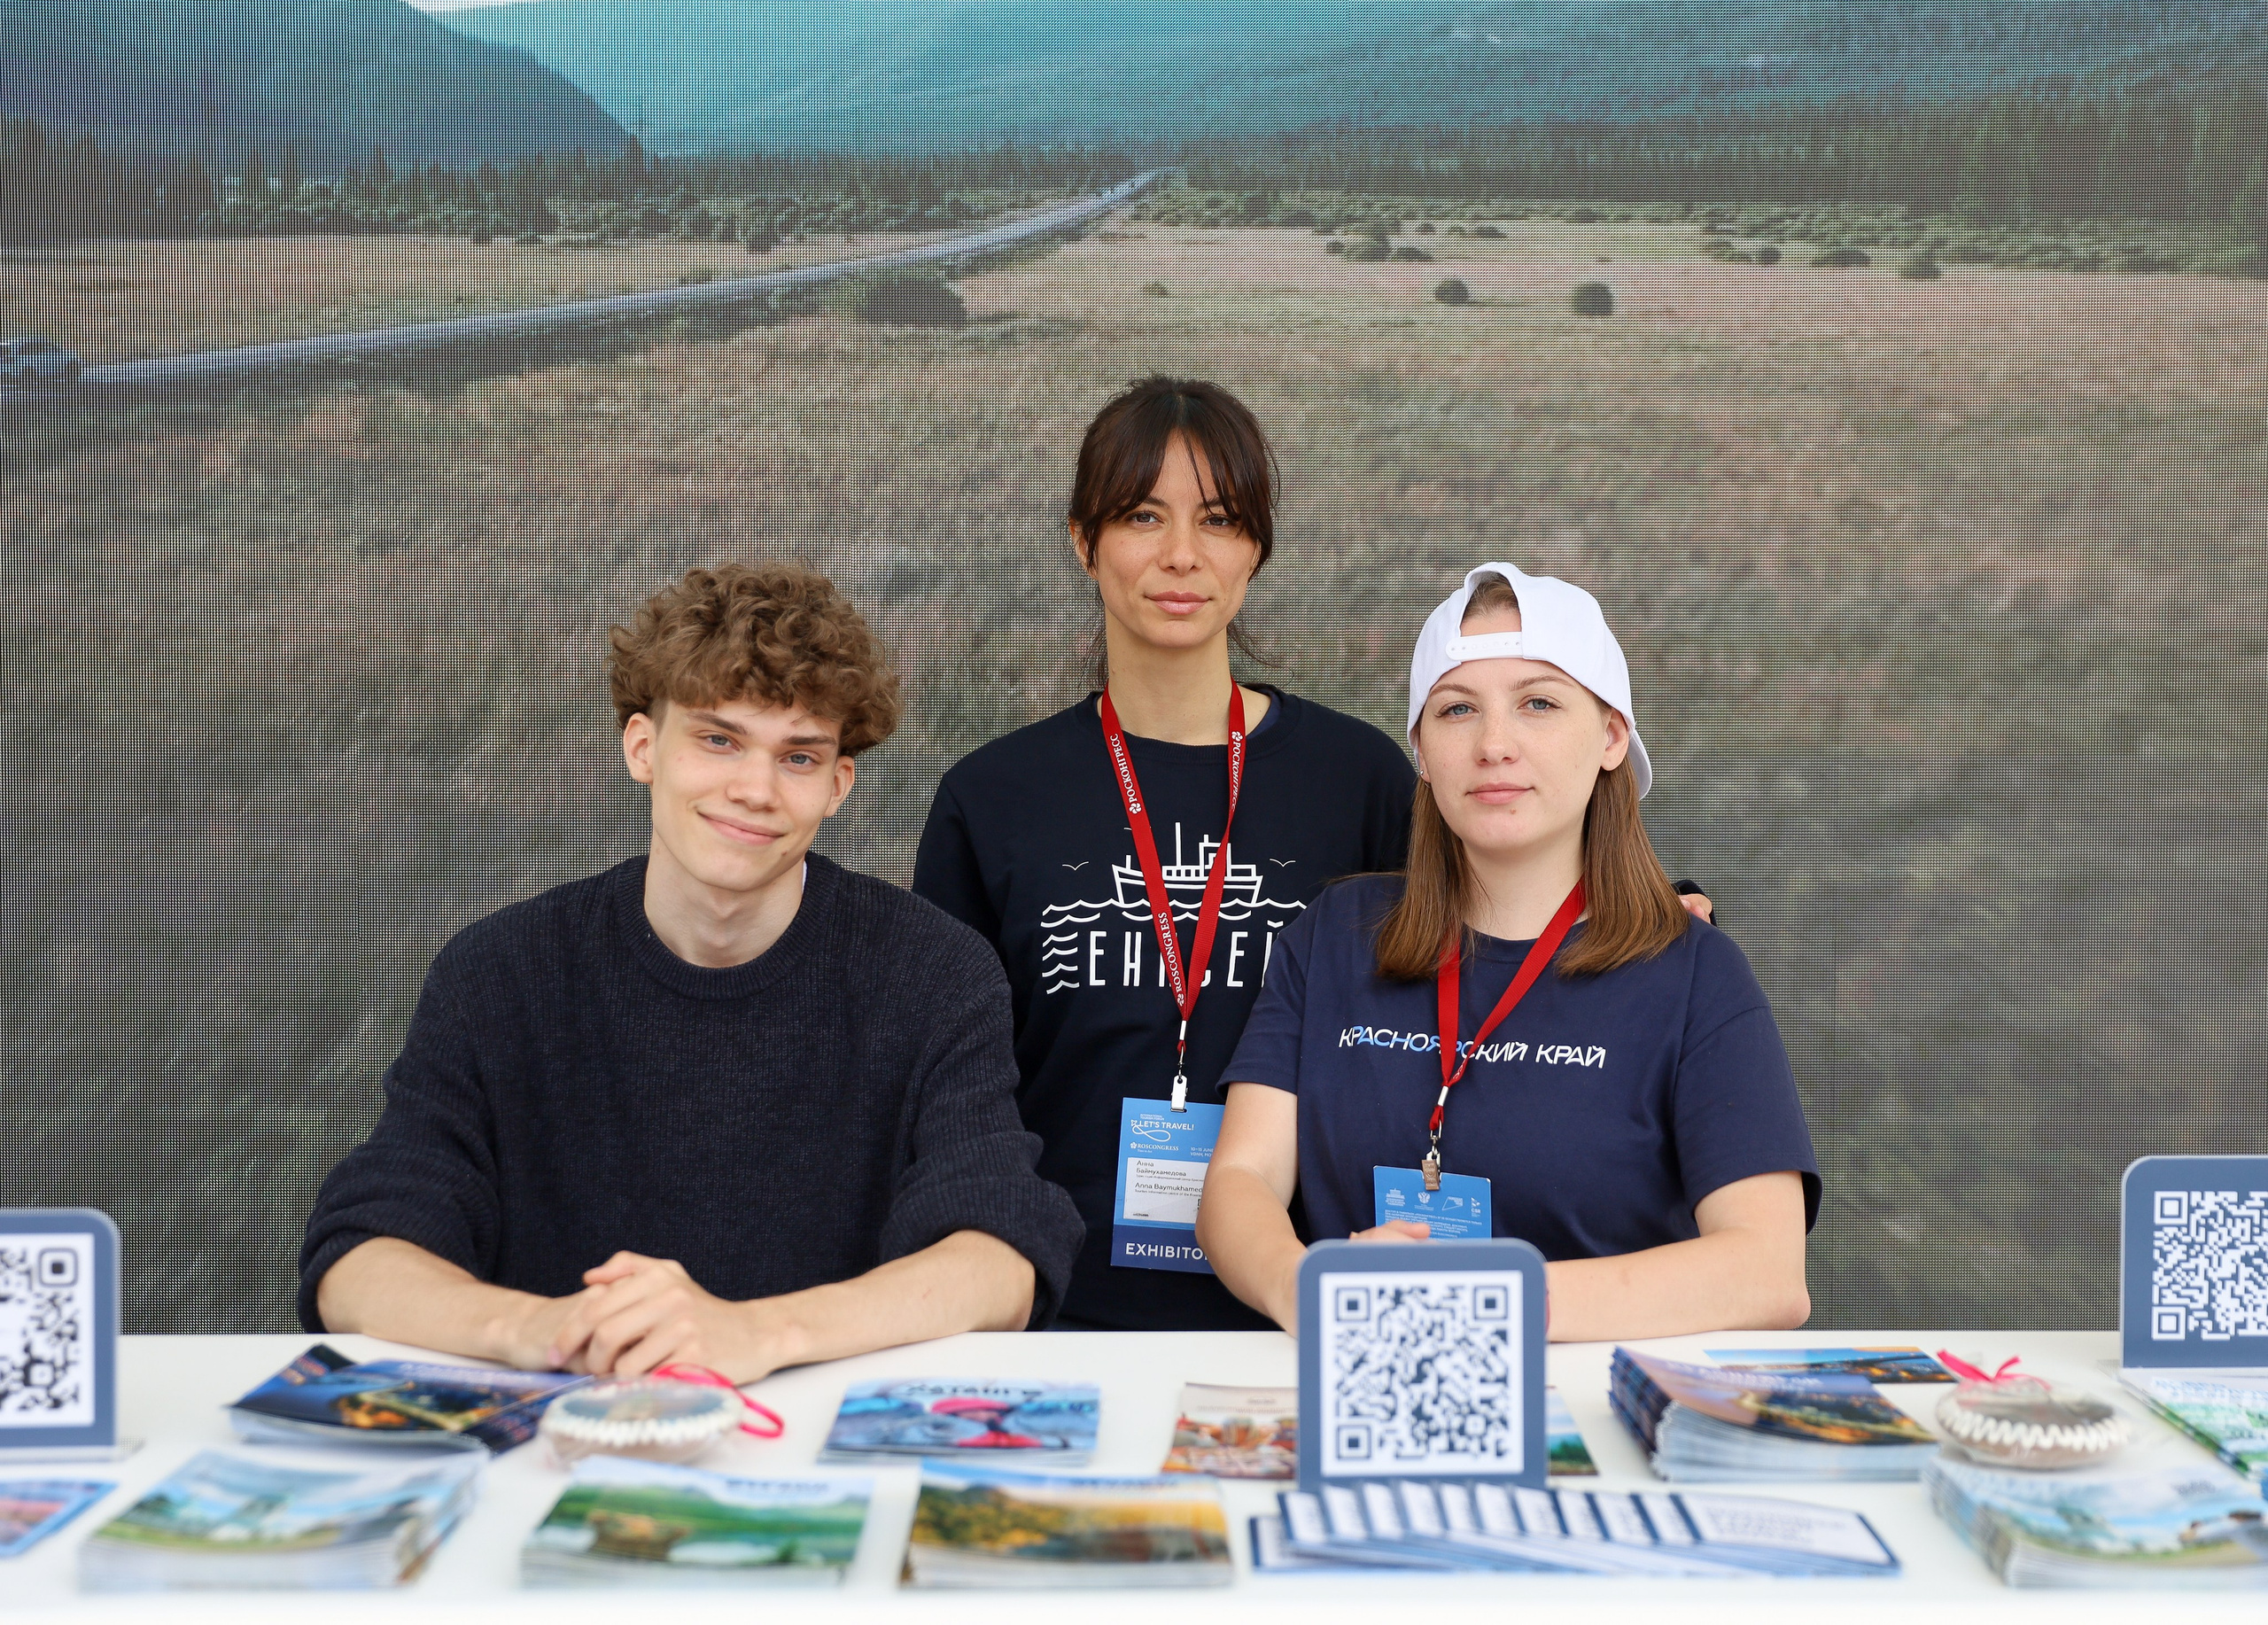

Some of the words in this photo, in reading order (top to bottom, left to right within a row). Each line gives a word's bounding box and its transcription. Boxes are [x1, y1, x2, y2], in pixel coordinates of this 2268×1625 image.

[1109, 733, 1138, 804] РОСКОНГРЕСС
[1158, 912, 1183, 993] ROSCONGRESS
[1535, 1044, 1606, 1069] КРАЙ
[1161, 1122, 1194, 1131] TRAVEL!
[1125, 1242, 1208, 1261] EXHIBITO
